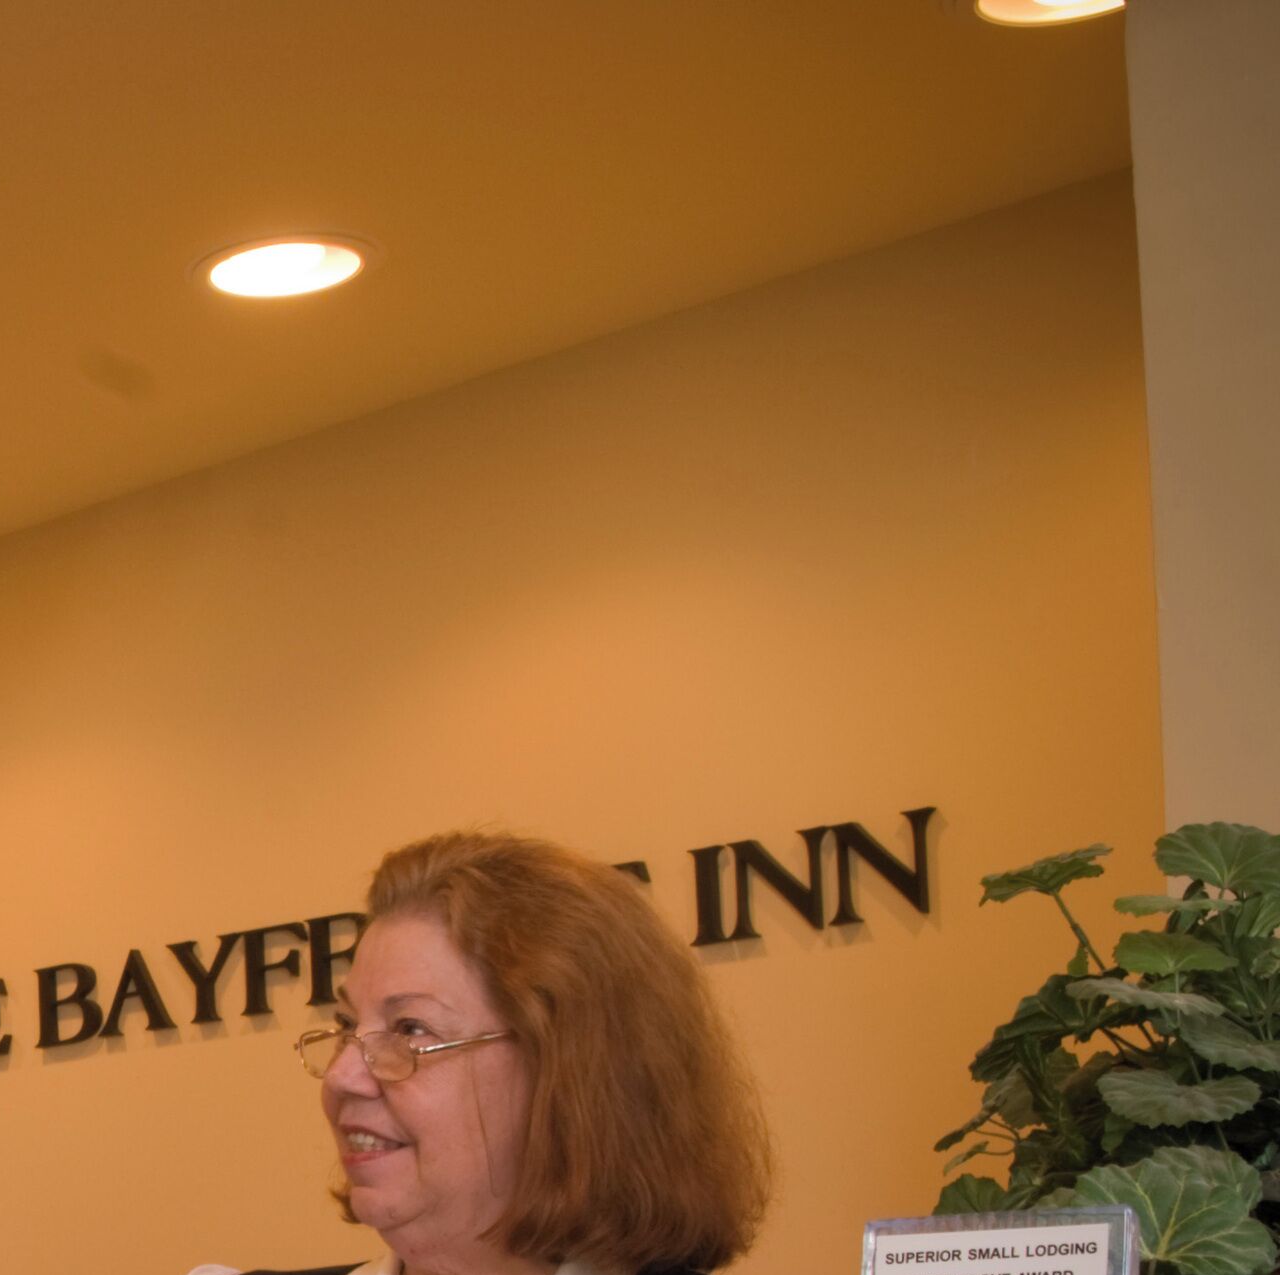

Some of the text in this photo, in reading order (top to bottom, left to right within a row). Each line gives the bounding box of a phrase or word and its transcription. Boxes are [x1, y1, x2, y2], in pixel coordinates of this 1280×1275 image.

[687, 806, 937, 948] INN
[885, 1242, 1098, 1265] SUPERIOR SMALL LODGING
